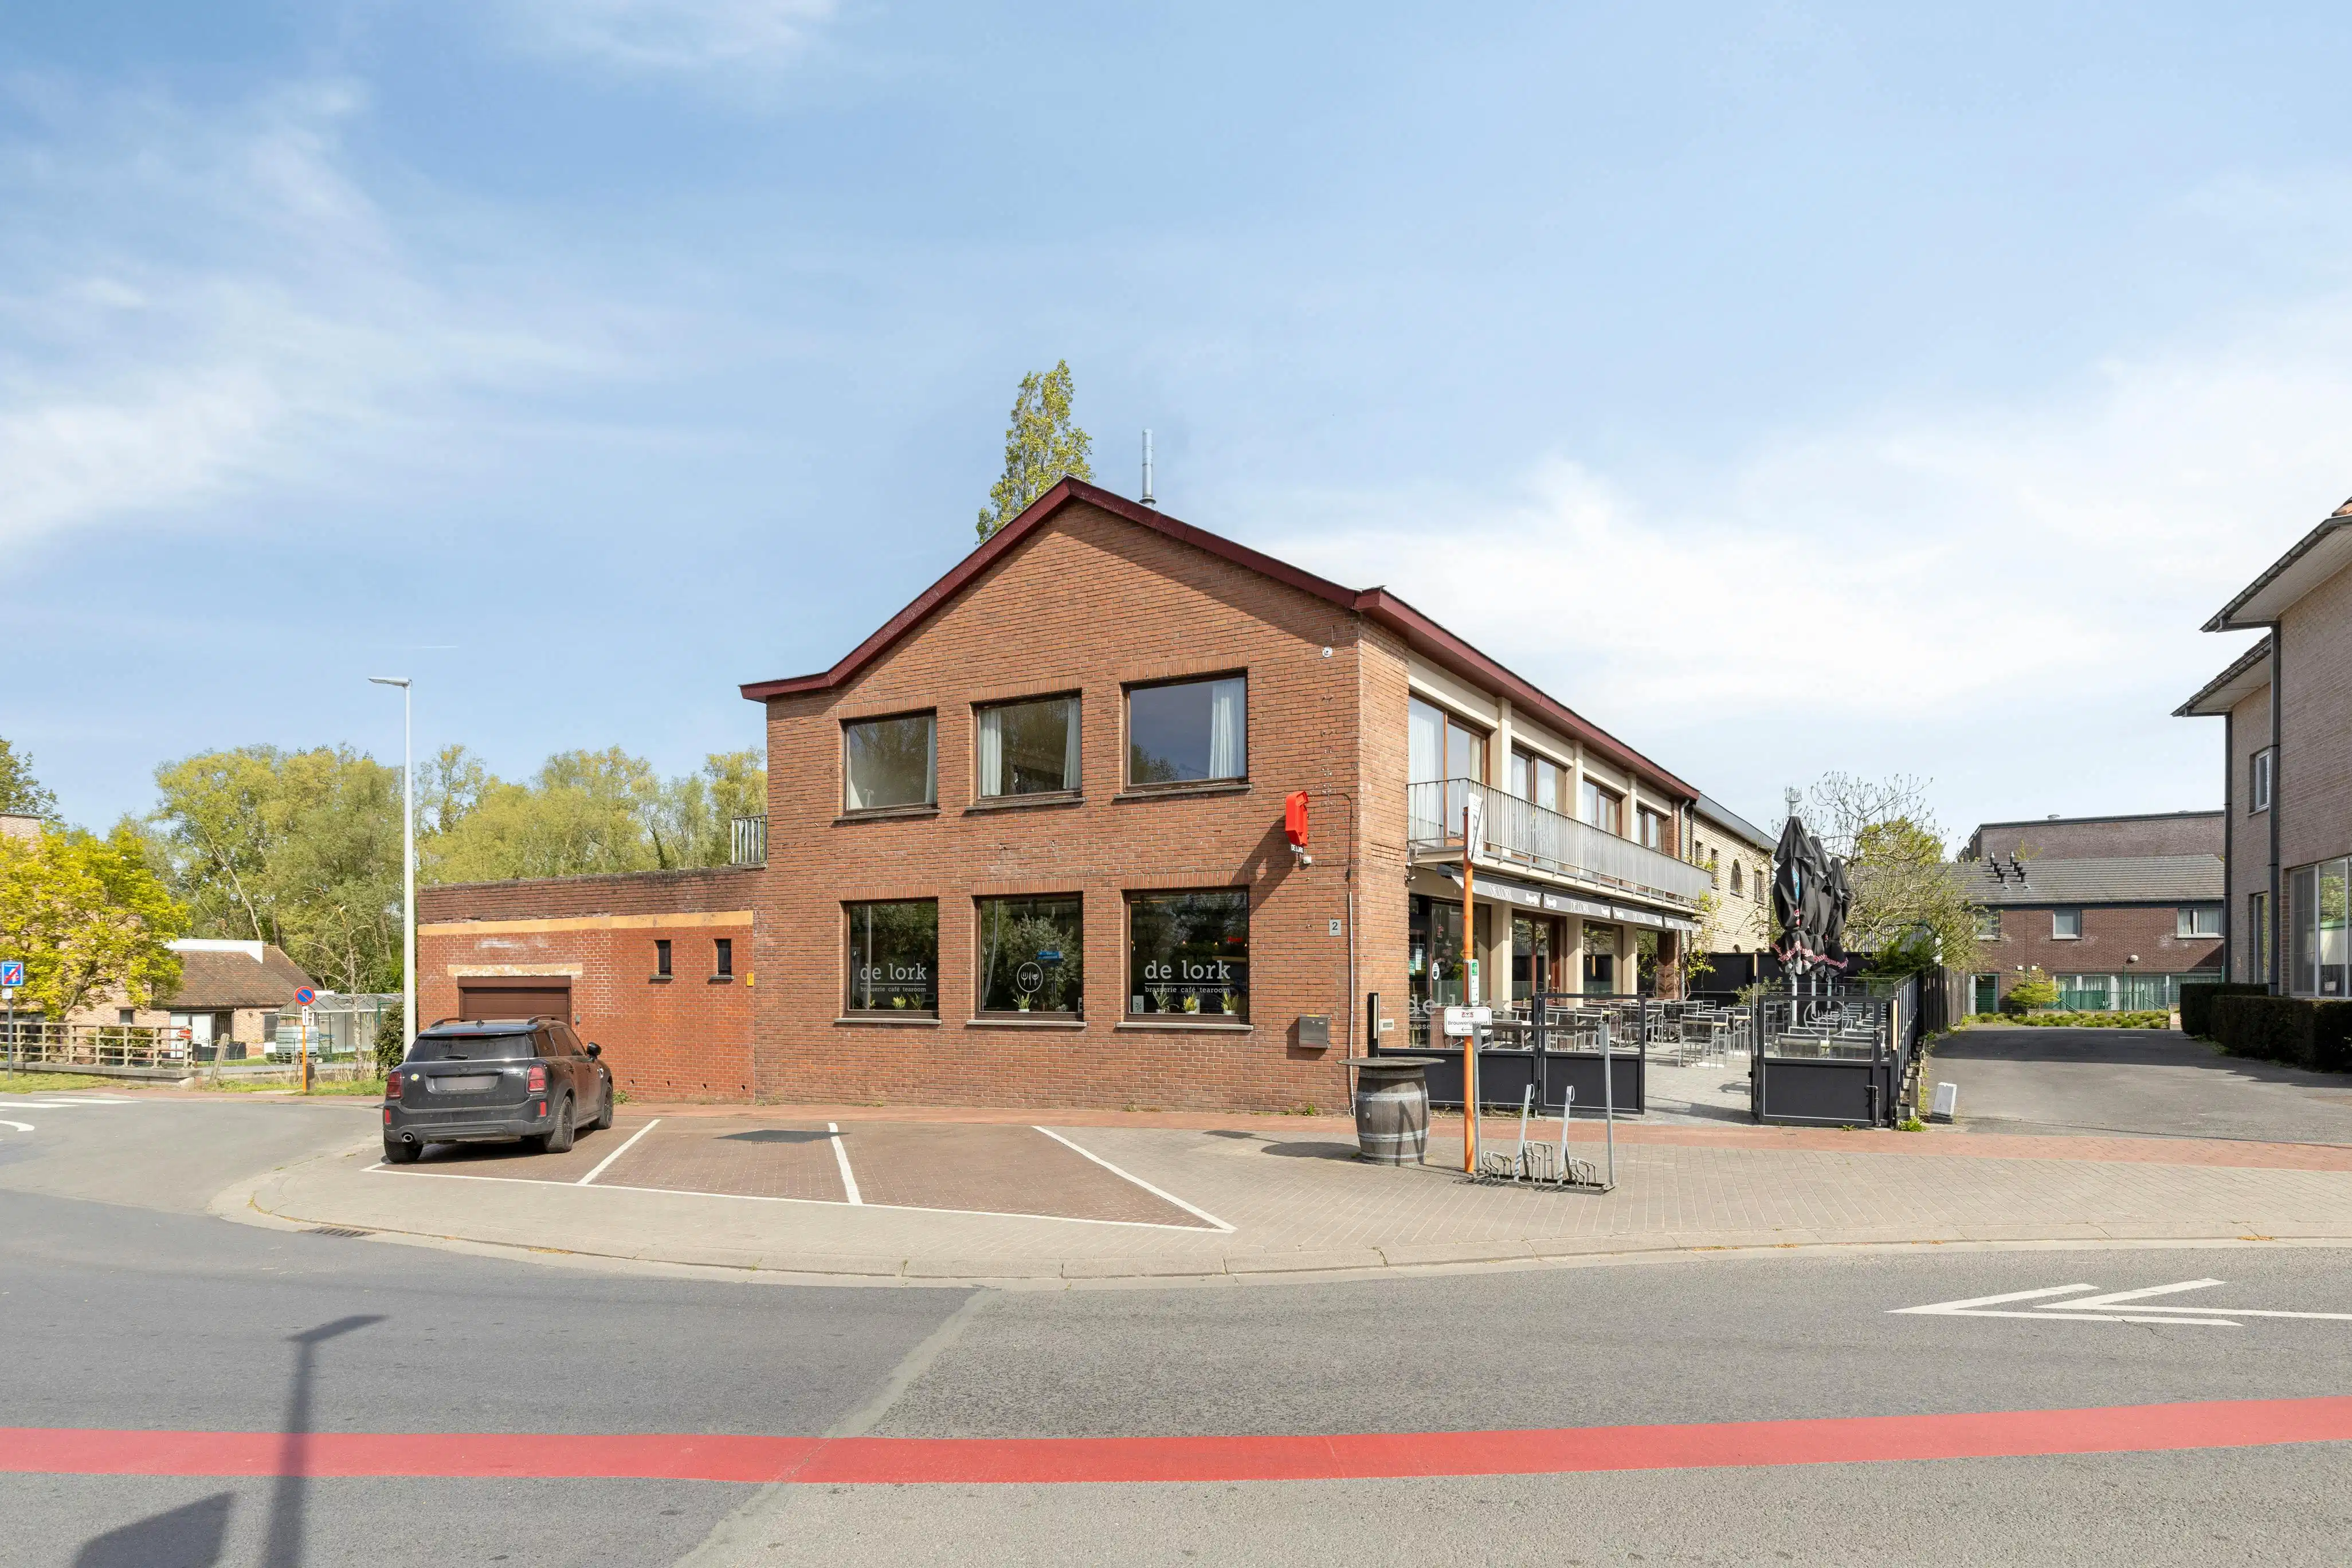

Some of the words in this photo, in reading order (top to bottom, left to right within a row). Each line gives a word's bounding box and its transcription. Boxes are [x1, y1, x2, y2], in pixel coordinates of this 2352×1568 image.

[1332, 922, 1338, 930] 2
[860, 963, 881, 980] de
[888, 963, 927, 980] lork
[1144, 960, 1172, 979] de
[1181, 960, 1230, 979] lork
[1405, 994, 1437, 1015] de
